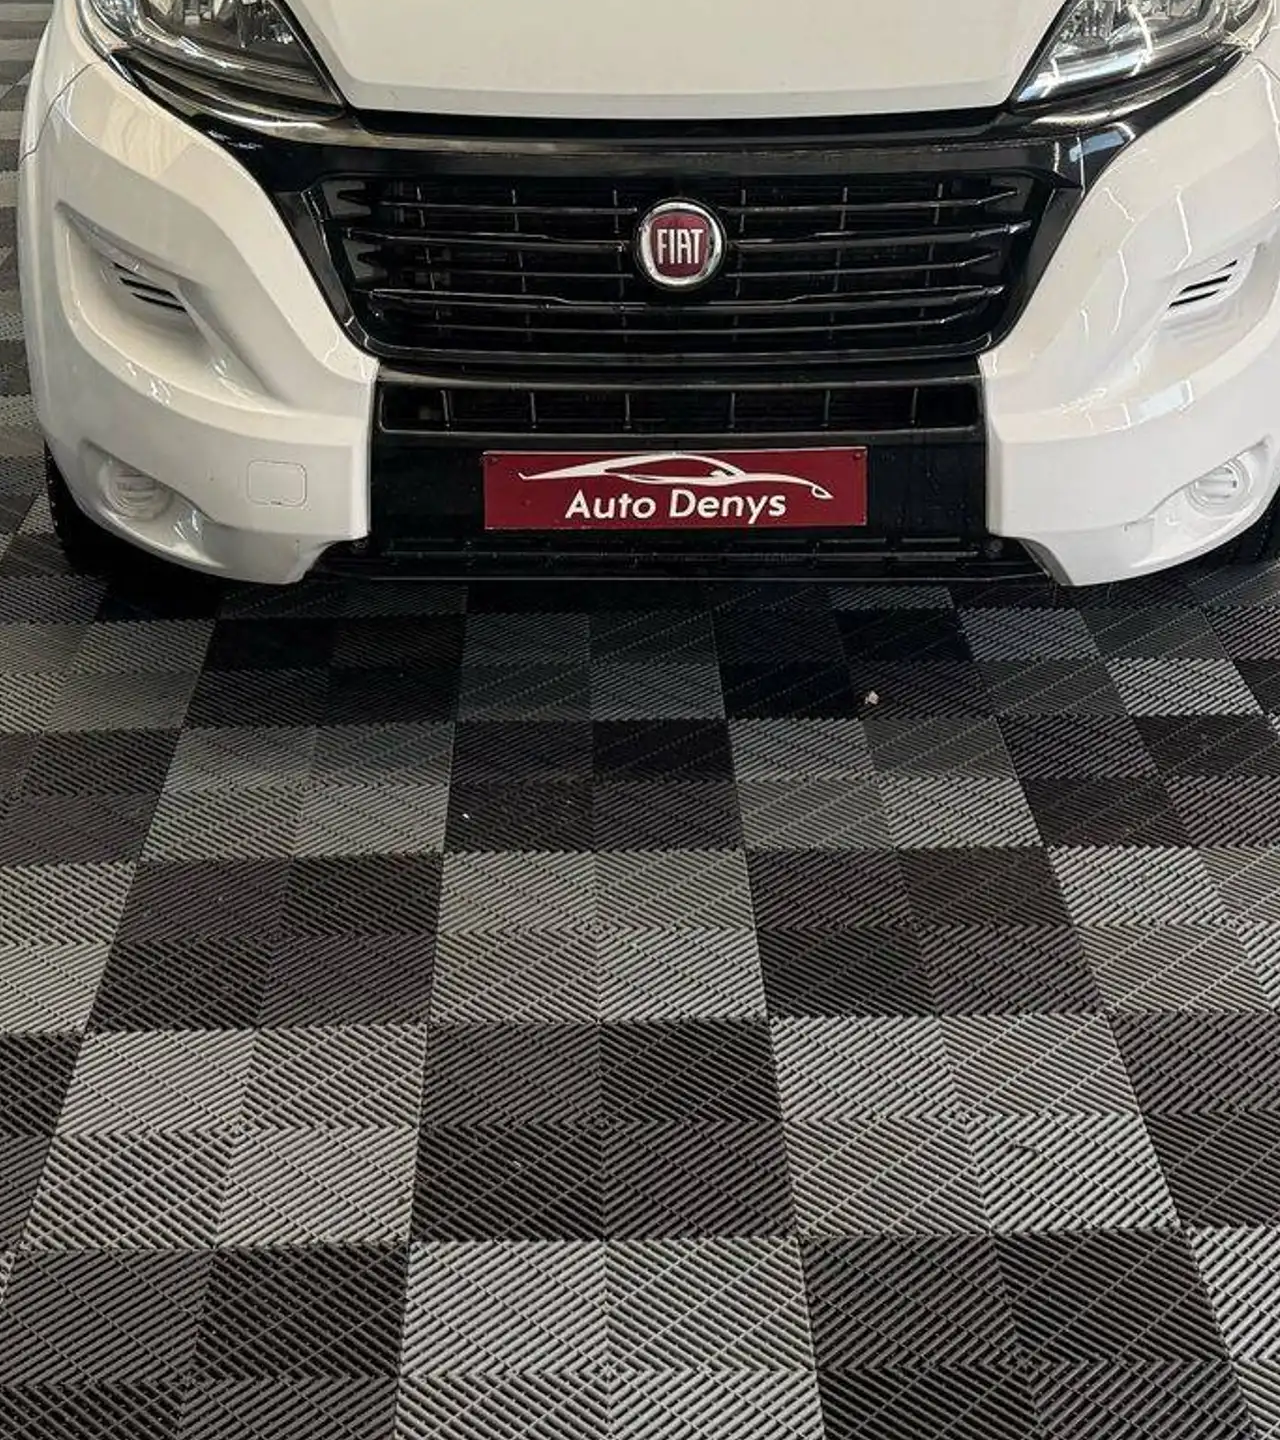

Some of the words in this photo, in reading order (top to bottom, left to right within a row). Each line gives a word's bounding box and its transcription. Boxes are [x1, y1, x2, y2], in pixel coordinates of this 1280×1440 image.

[657, 229, 704, 264] FIAT
[565, 489, 656, 519] Auto
[670, 489, 786, 525] Denys
